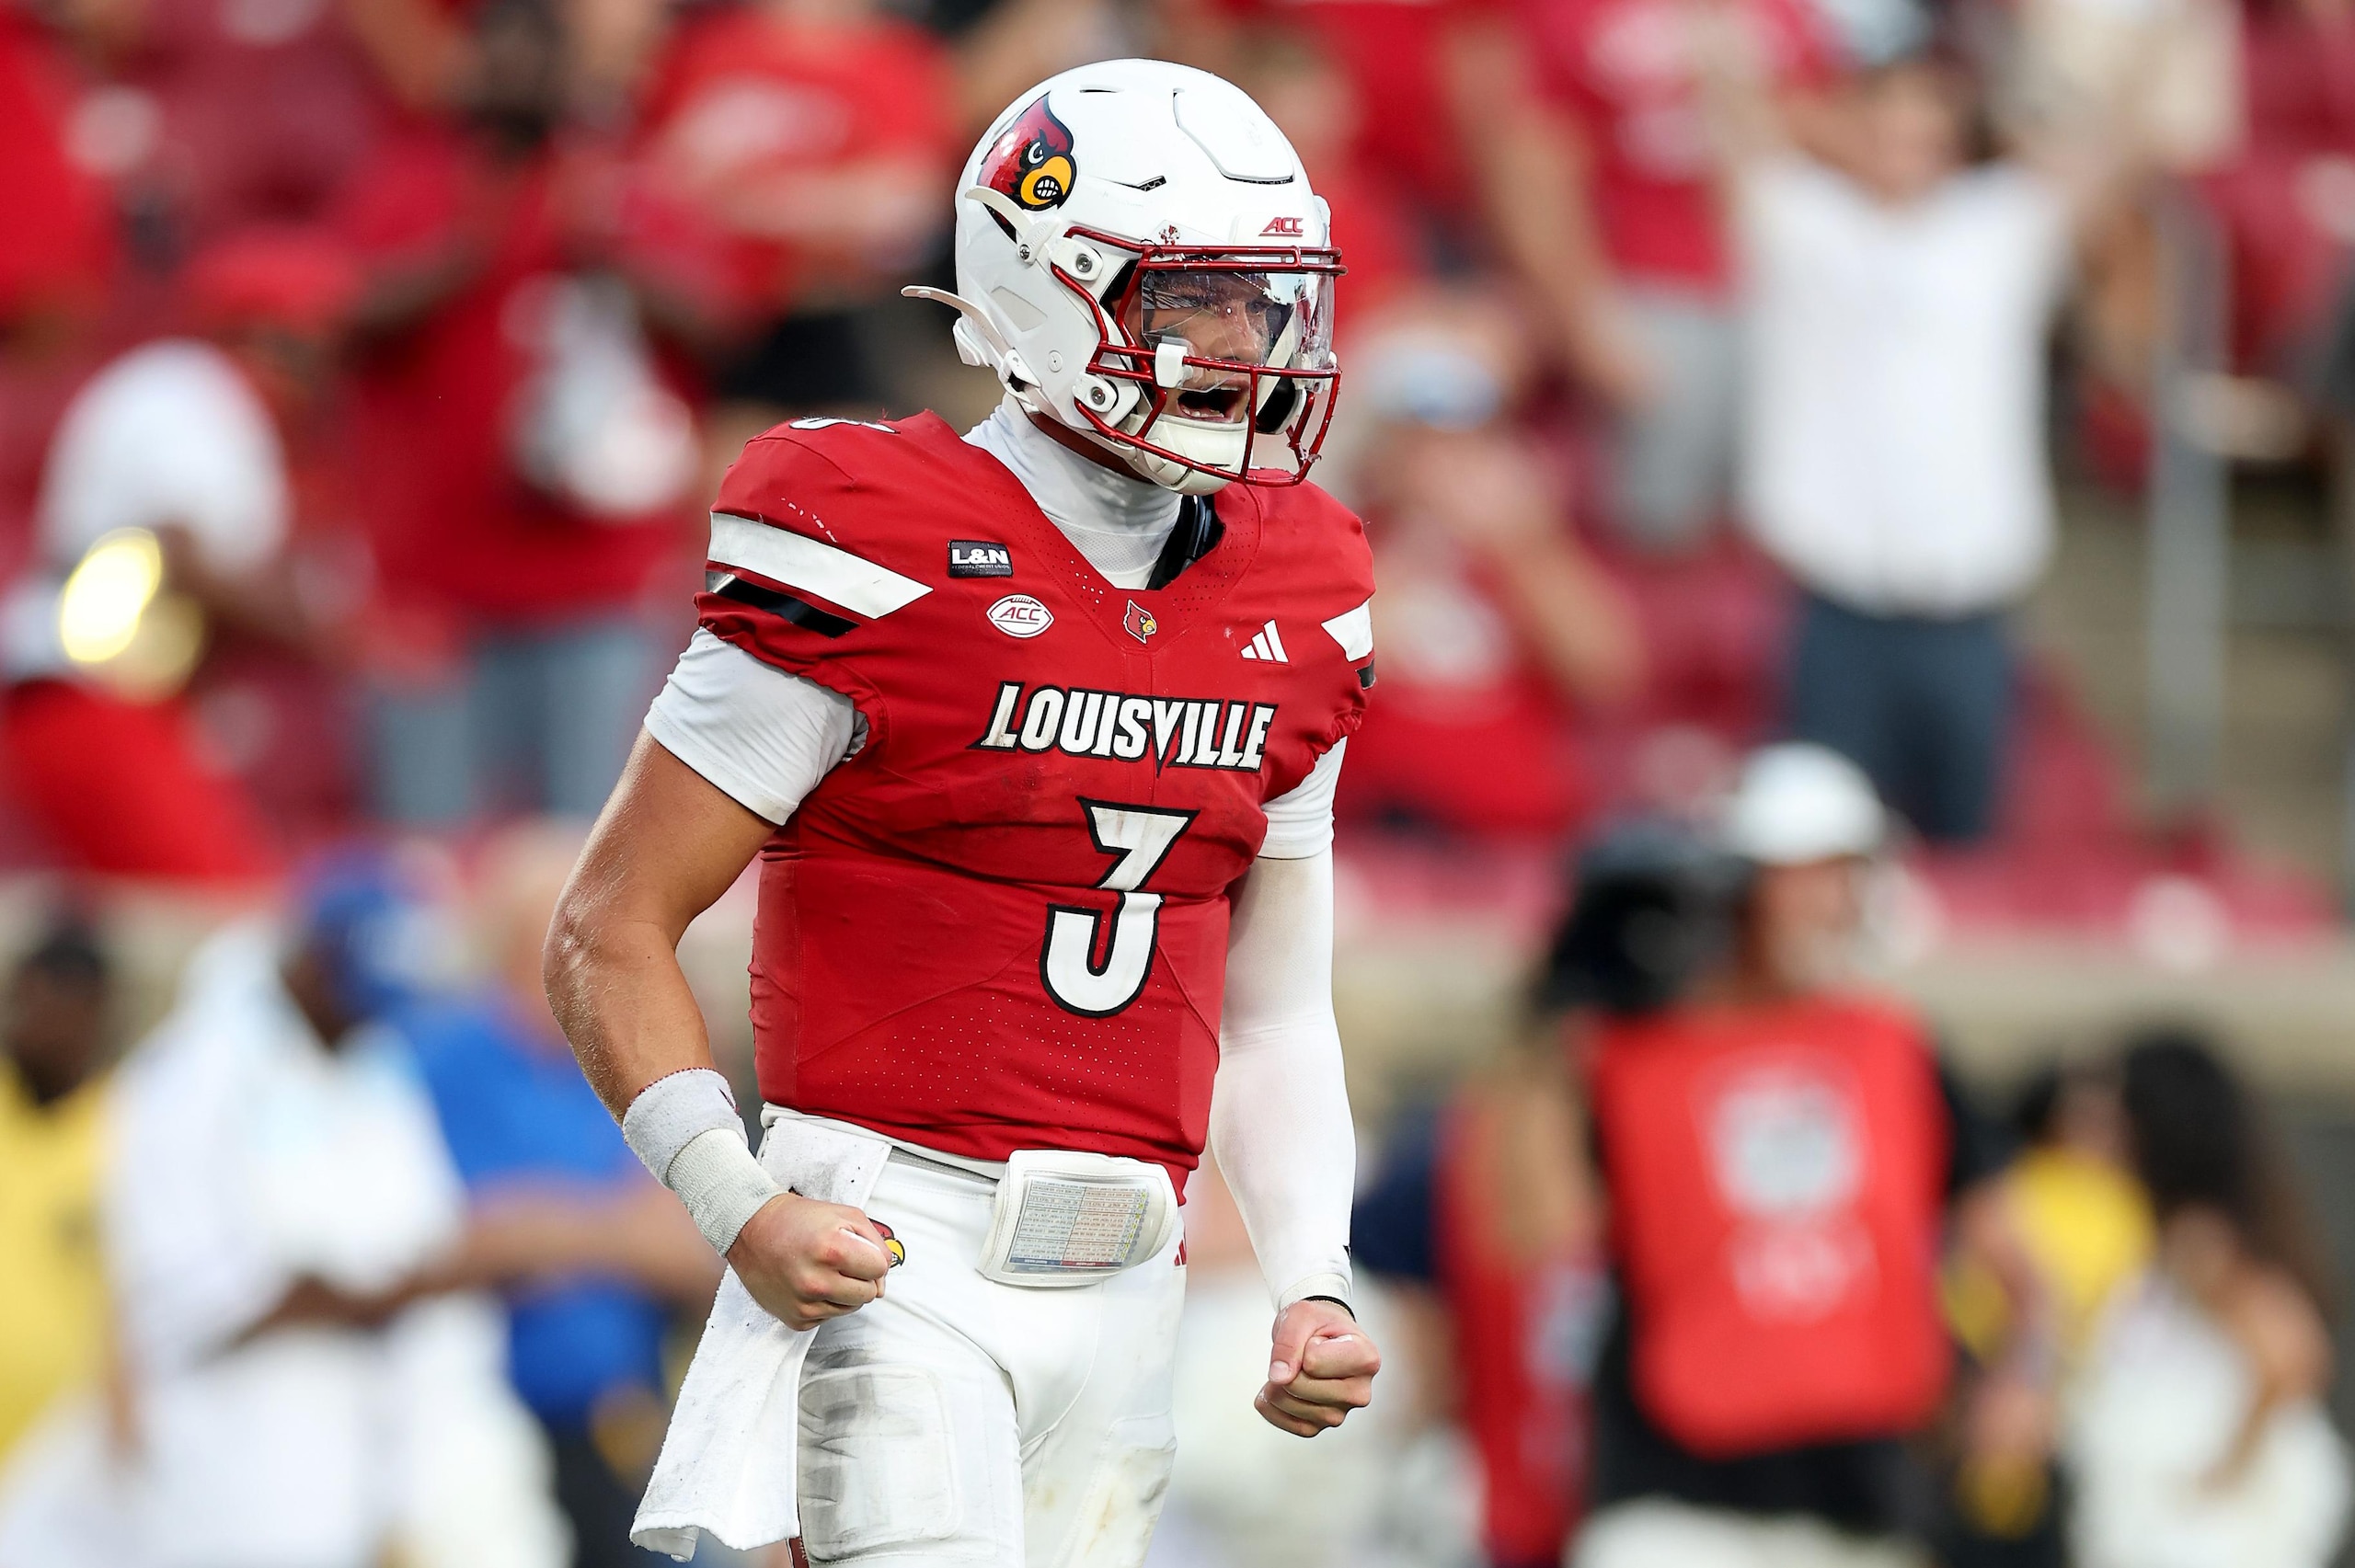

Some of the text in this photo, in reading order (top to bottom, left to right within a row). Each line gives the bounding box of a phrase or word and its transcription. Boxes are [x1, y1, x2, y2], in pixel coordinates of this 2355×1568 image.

[1261, 216, 1304, 234] ACC
[951, 548, 1009, 565] L&N
[998, 606, 1041, 622] ACC
[968, 681, 1279, 776] LOUISVILLE
[1040, 796, 1200, 1018] 3
